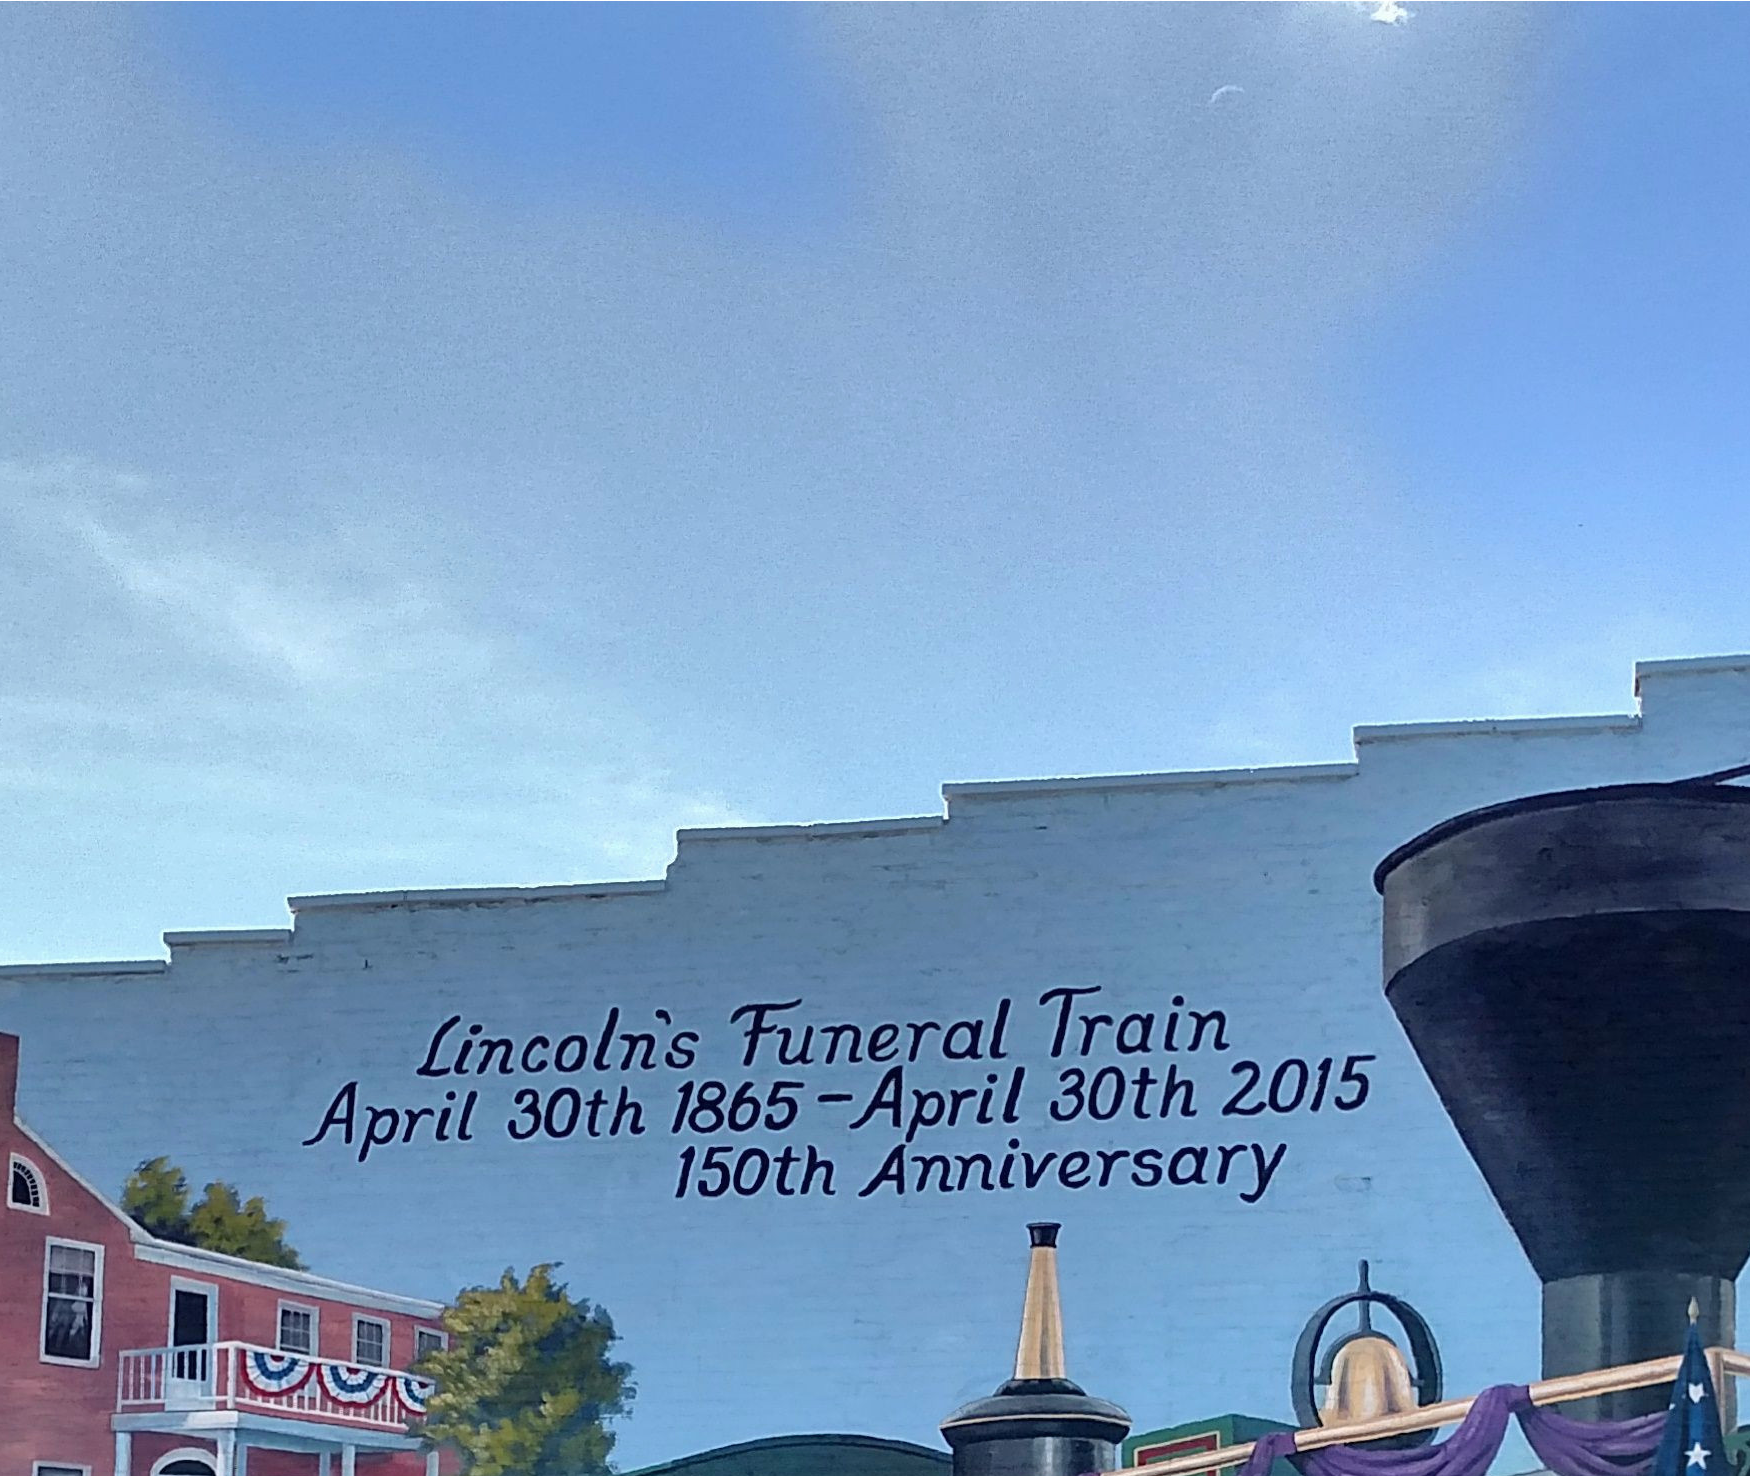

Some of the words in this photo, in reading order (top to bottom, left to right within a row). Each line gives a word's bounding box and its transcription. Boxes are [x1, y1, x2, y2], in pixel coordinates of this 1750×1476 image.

[415, 1006, 700, 1078] Lincoln's
[729, 998, 1012, 1067] Funeral
[1039, 985, 1231, 1058] Train
[301, 1080, 479, 1163] April
[507, 1085, 646, 1140] 30th
[1049, 1063, 1198, 1122] 30th
[1221, 1054, 1377, 1116] 2015
[675, 1143, 836, 1199] 150th
[857, 1142, 1287, 1204] Anniversary
